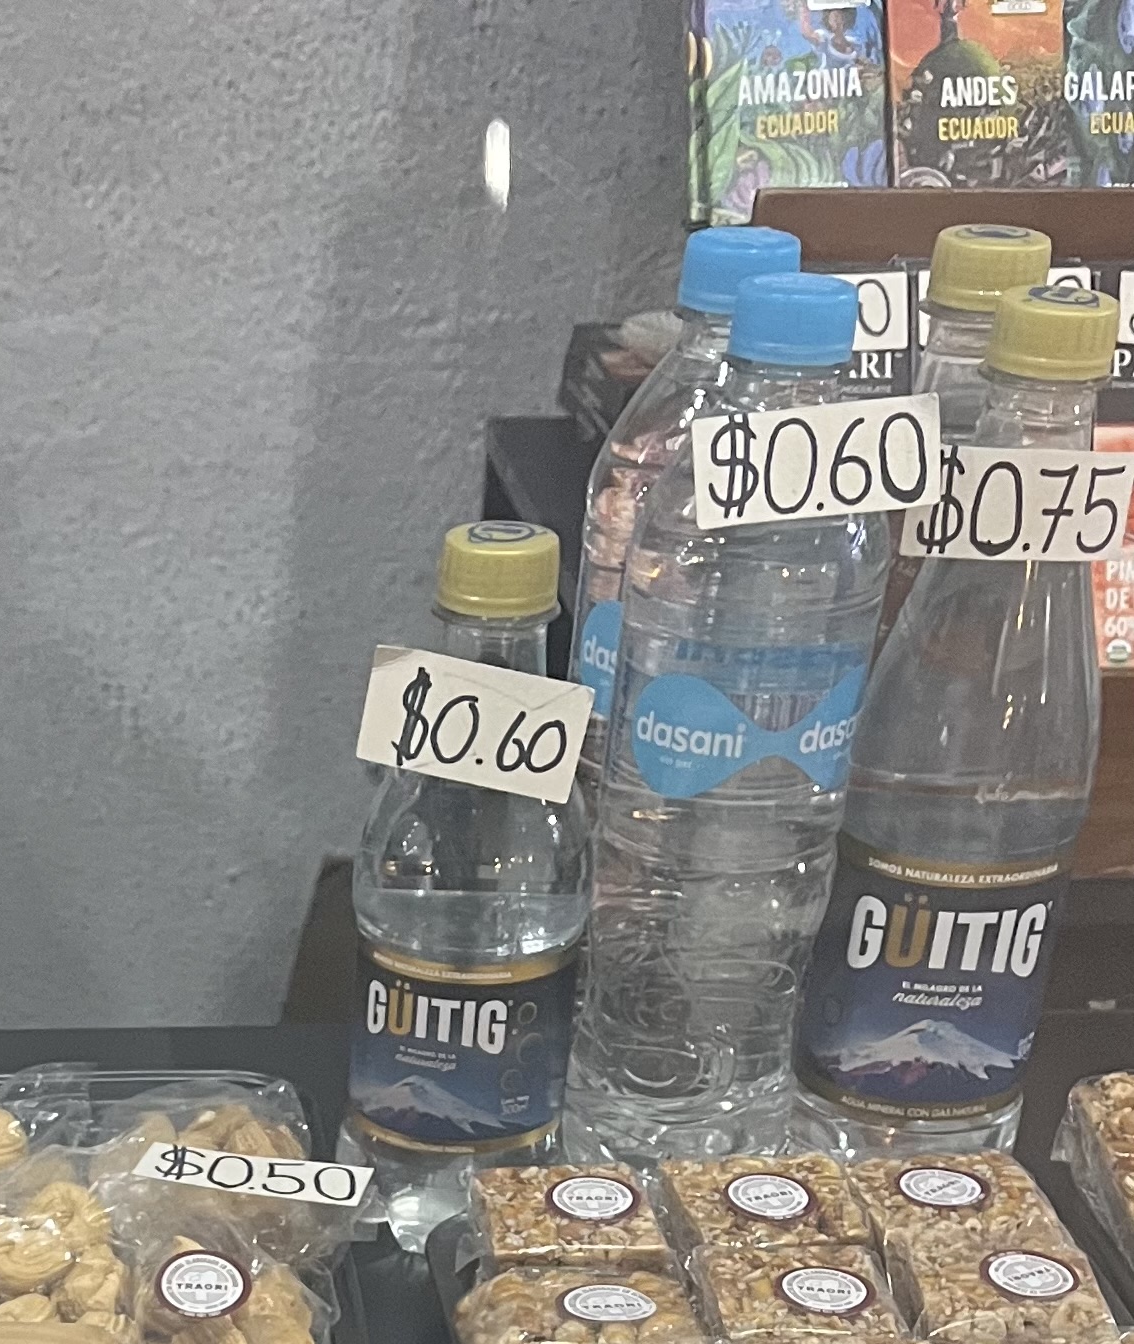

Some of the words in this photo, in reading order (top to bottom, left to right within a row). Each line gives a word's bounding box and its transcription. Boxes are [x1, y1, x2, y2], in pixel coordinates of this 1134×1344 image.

[738, 67, 863, 106] AMAZONIA
[940, 76, 1018, 107] ANDES
[755, 110, 839, 139] ECUADOR
[938, 116, 1018, 141] ECUADOR
[708, 411, 927, 519] $0.60
[916, 444, 1126, 557] $0.75
[391, 666, 567, 773] $0.60
[636, 710, 747, 759] dasani
[846, 892, 1047, 978] GÜITIG
[367, 979, 508, 1055] GÜITIG
[155, 1144, 356, 1201] $0.50
[177, 1283, 228, 1291] TRAORI
[799, 1285, 851, 1295] TRAORI
